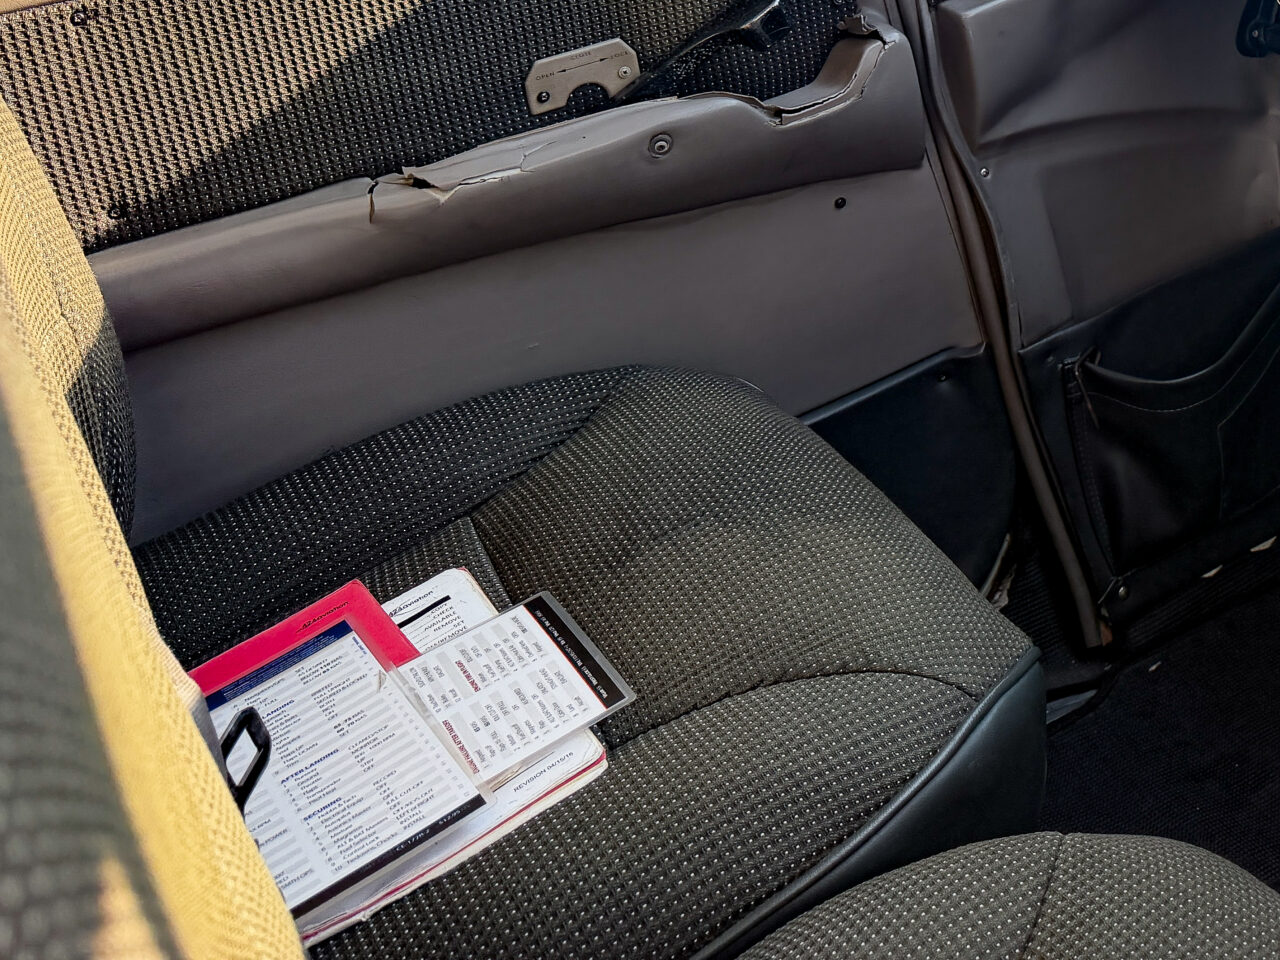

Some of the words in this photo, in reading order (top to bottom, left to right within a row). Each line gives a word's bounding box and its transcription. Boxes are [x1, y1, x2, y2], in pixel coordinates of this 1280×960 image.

[536, 72, 555, 80] OPEN
[424, 611, 457, 632] AVAILABLE
[433, 606, 454, 620] CHECK
[433, 616, 462, 633] REMOVE
[453, 620, 466, 629] SET
[261, 698, 296, 720] LANDING
[350, 736, 379, 755] MONITOR
[279, 767, 306, 784] AFTER
[303, 747, 340, 770] LANDING
[359, 757, 375, 768] STBY
[514, 769, 547, 792] REVISION
[547, 752, 574, 771] 04/15/16
[375, 781, 388, 791] OFF
[301, 796, 343, 822] SECURING
